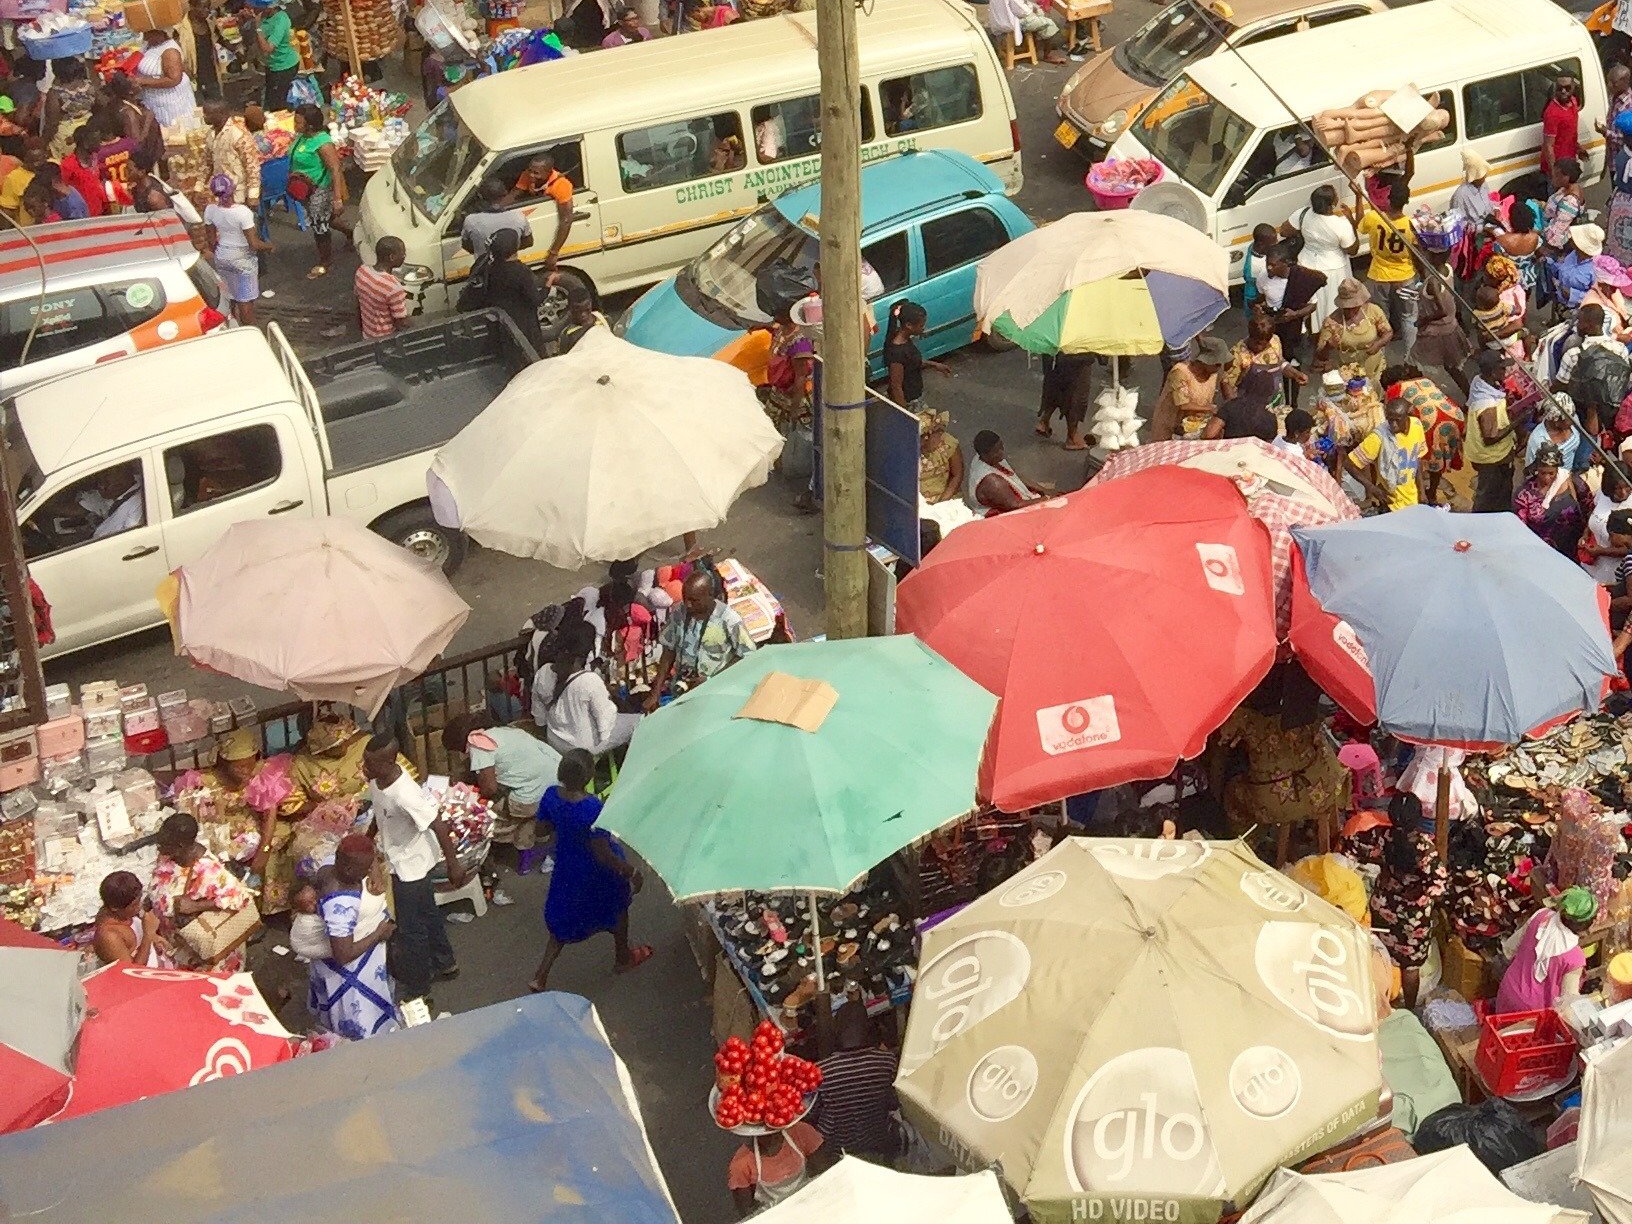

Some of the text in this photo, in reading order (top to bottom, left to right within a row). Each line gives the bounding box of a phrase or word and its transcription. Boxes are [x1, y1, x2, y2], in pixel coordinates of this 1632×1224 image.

[675, 177, 734, 205] CHRIST
[29, 298, 76, 315] SONY
[1051, 730, 1108, 752] vodafone
[1293, 927, 1366, 1018] glo
[924, 954, 993, 1043] glo
[982, 1062, 1022, 1102] glo
[1242, 1062, 1286, 1105] glo
[1340, 1098, 1368, 1128] DATA
[1093, 1093, 1205, 1183] glo
[1072, 1198, 1181, 1222] HD VIDEO
